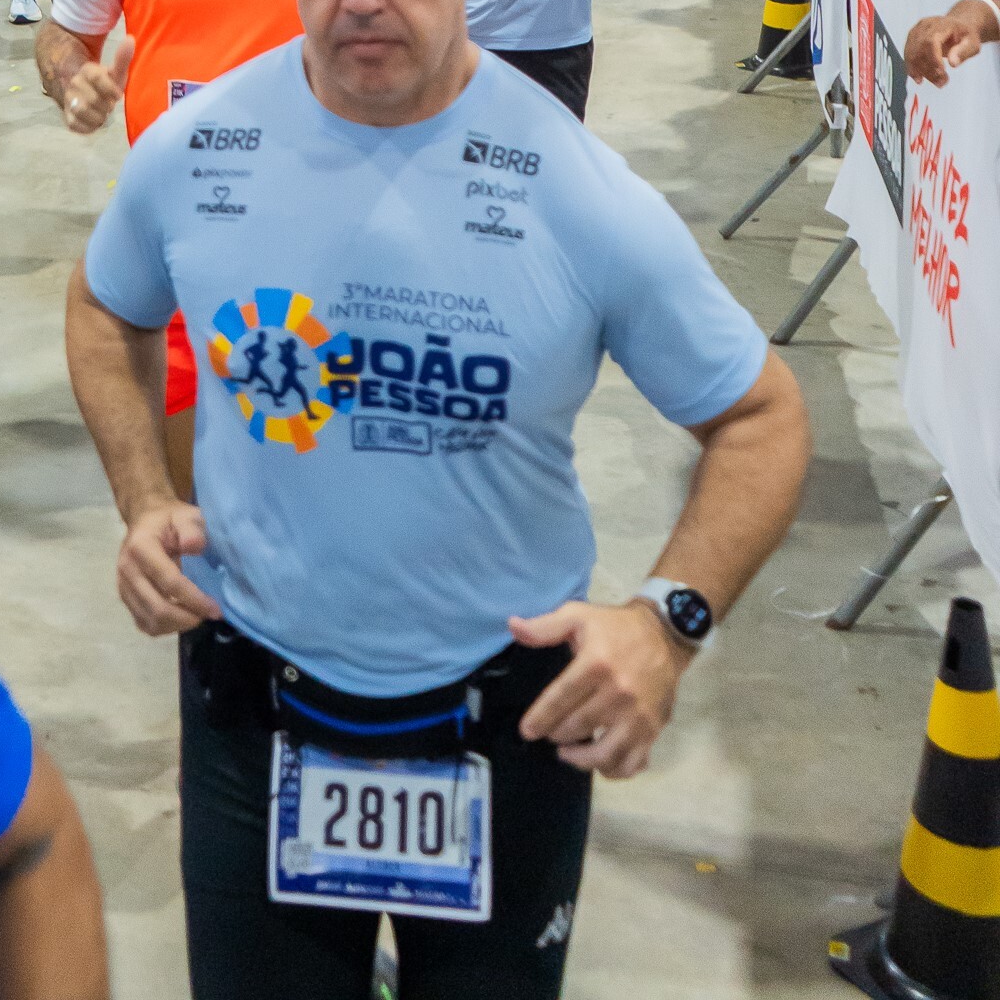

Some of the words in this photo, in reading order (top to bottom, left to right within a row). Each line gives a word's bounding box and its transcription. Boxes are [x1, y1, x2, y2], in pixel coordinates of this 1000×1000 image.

[214, 127, 262, 151] BRB
[489, 144, 542, 176] BRB
[465, 179, 529, 206] pixbet
[463, 220, 526, 240] mateus
[327, 300, 512, 338] INTERNACIONAL
[325, 331, 512, 396] JOÃO
[327, 377, 509, 423] PESSOA
[322, 782, 446, 857] 2810
